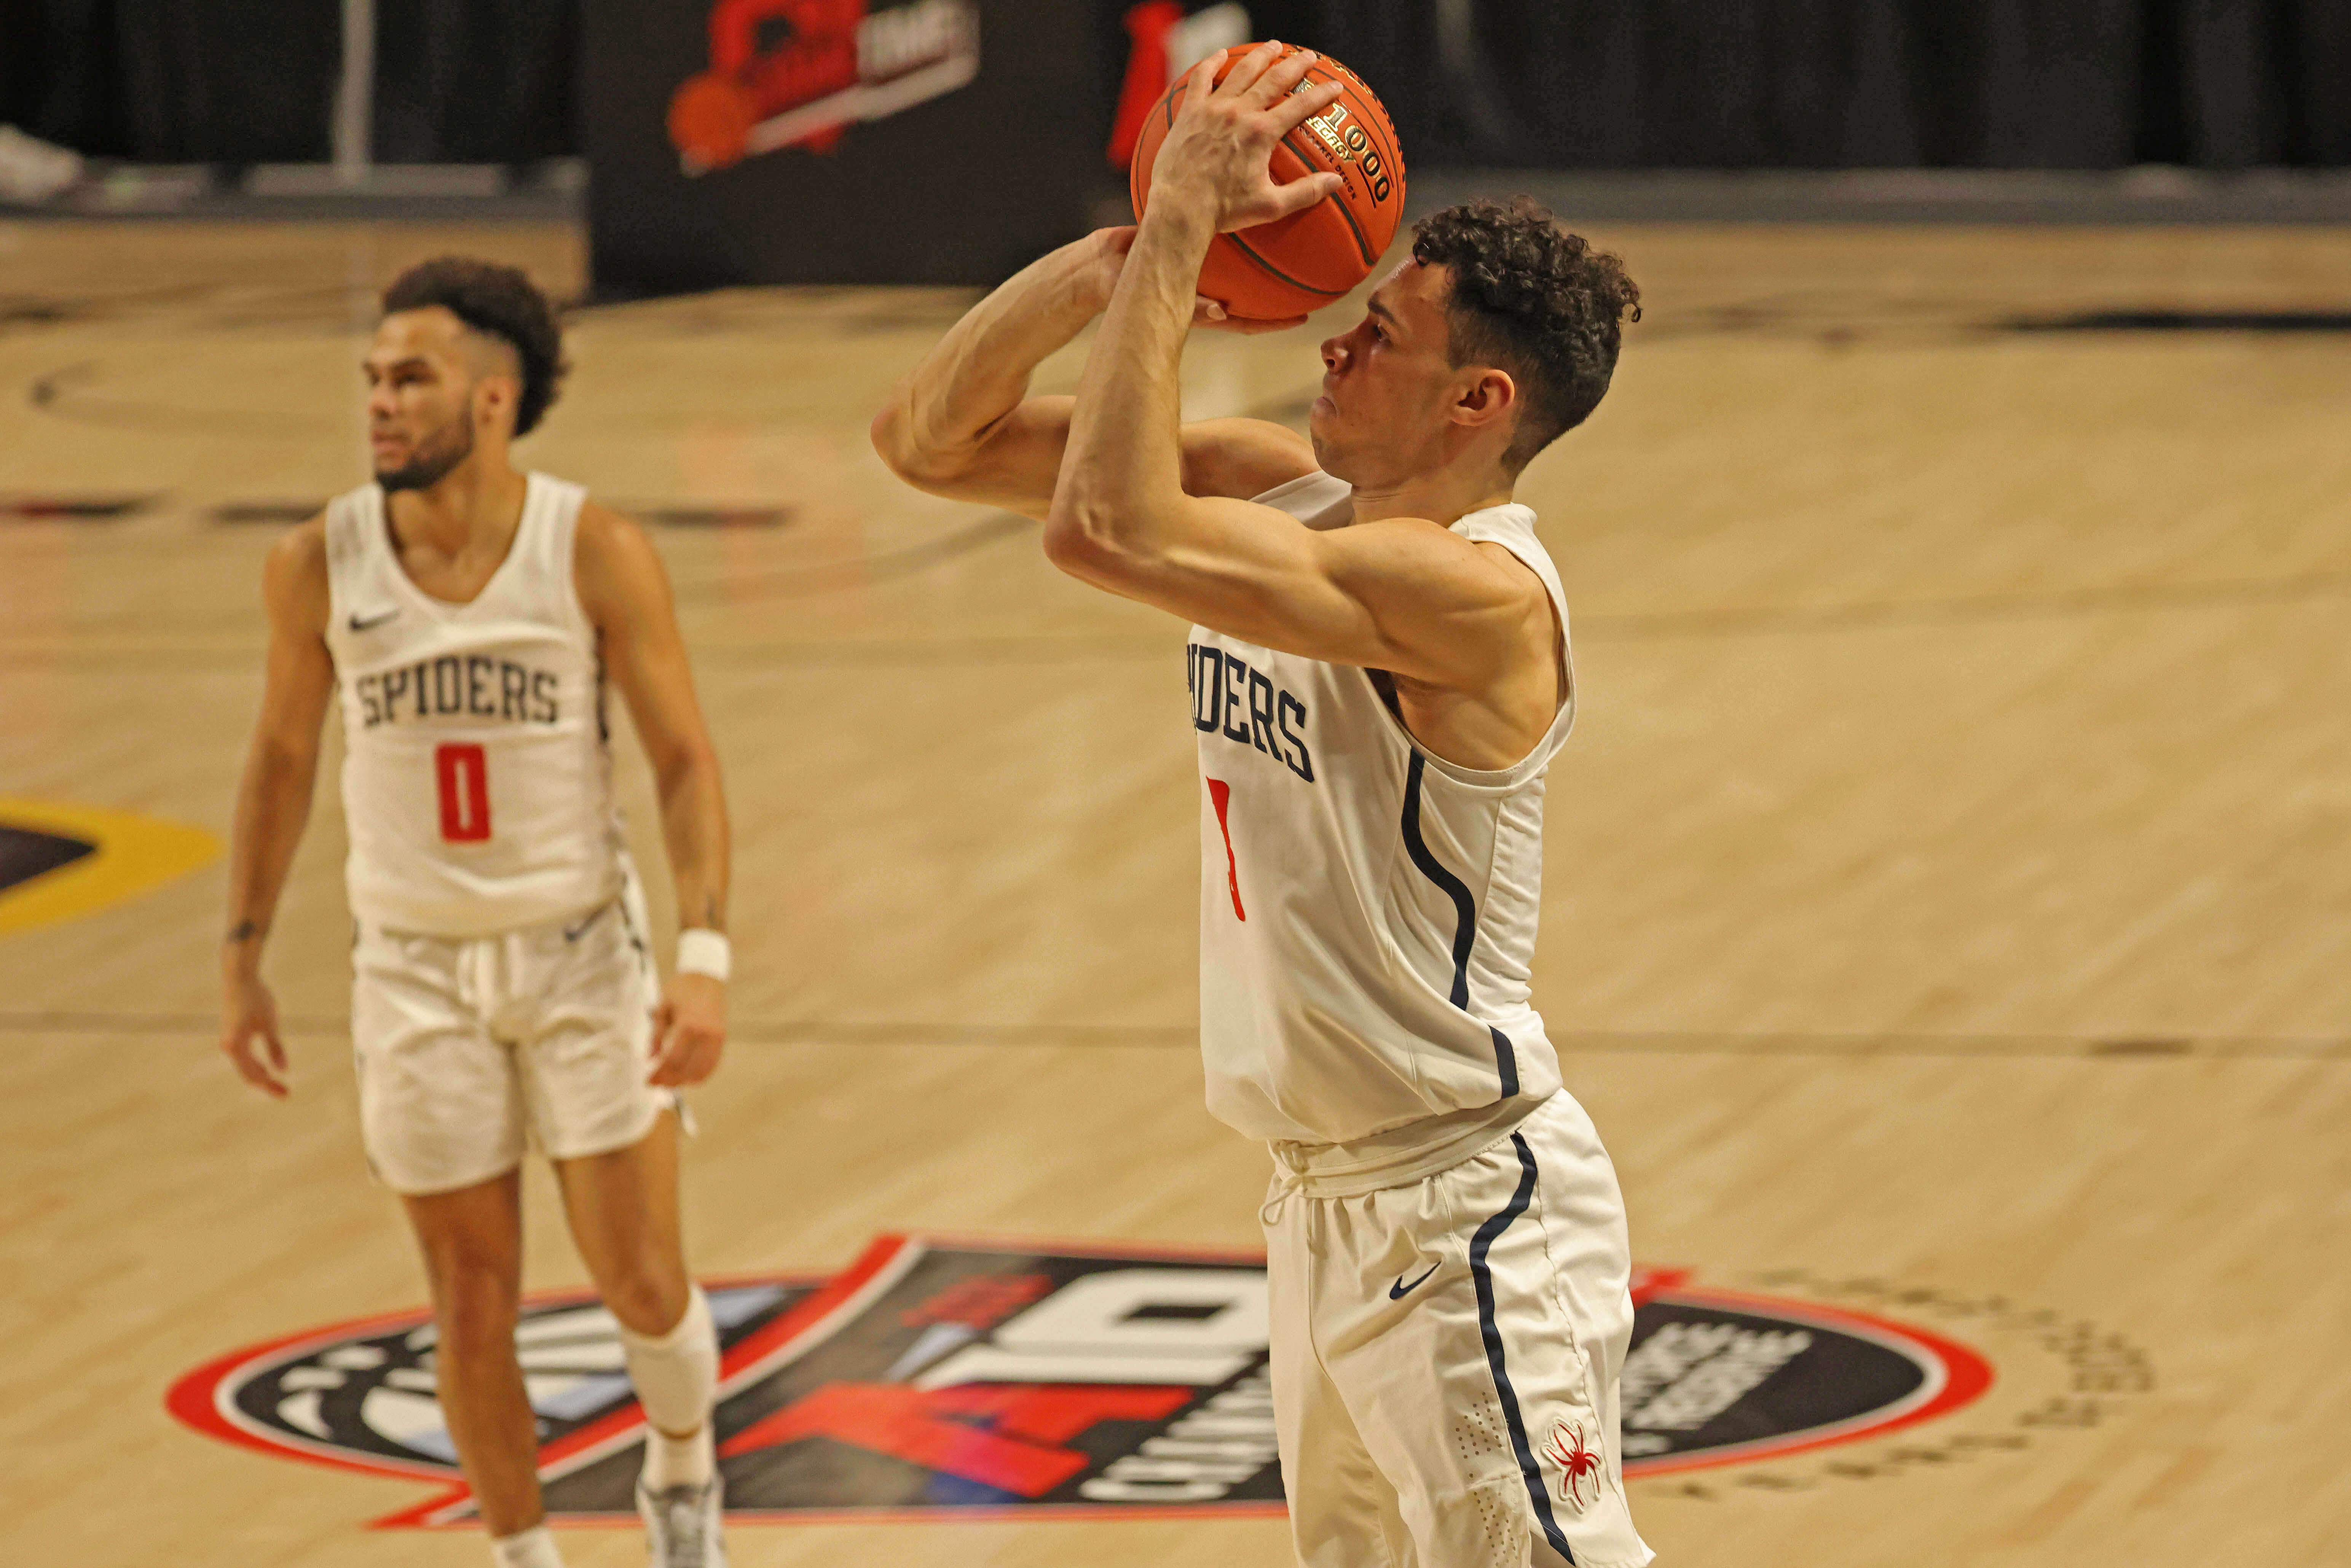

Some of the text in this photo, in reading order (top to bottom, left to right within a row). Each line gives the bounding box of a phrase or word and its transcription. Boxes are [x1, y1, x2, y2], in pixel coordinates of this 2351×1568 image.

[1306, 115, 1355, 162] EGACY
[1334, 165, 1357, 200] DESIGN
[356, 654, 558, 727] SPIDERS
[1187, 644, 1314, 783] IDERS
[435, 742, 492, 844] 0
